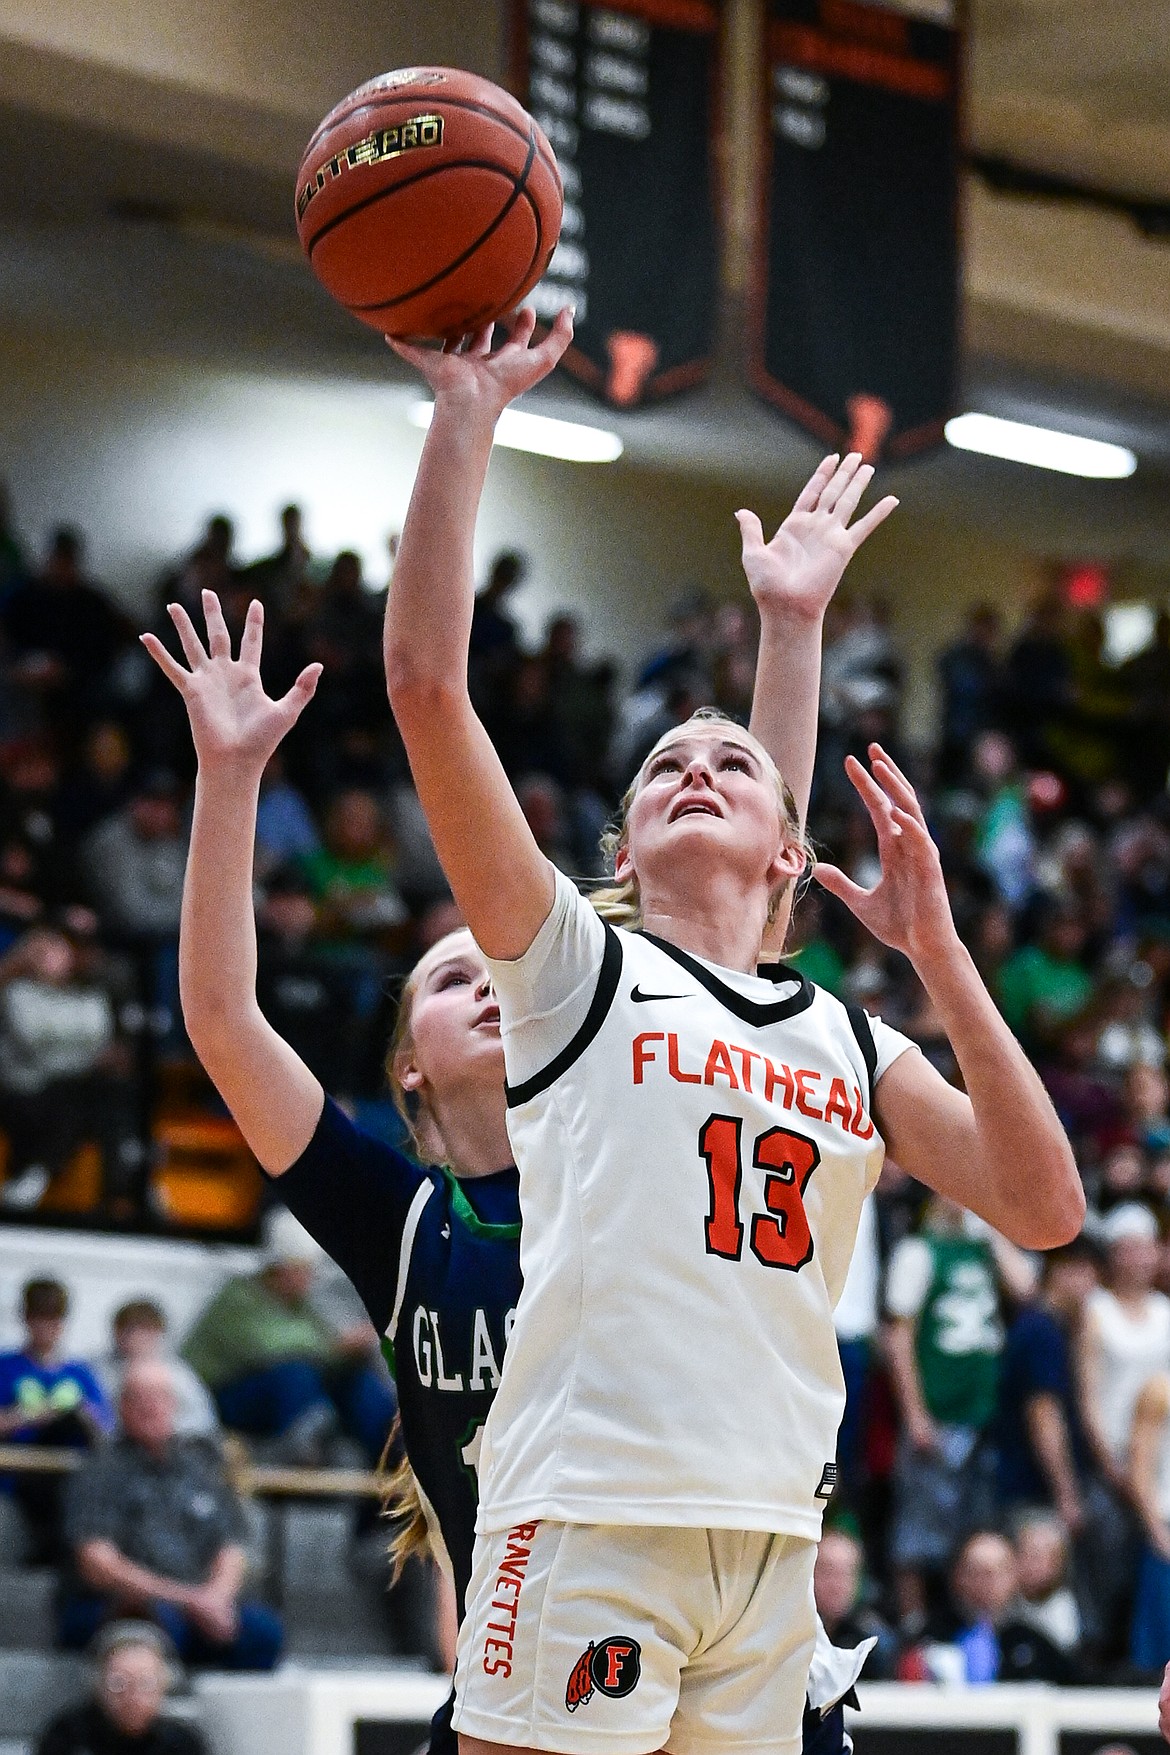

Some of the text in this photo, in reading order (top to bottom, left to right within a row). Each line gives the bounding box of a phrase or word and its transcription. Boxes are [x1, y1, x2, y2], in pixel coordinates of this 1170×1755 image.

[296, 116, 443, 222] ELITE PRO
[698, 1112, 821, 1273] 13
[482, 1519, 542, 1679] RAVETTES
[603, 1645, 633, 1688] F
